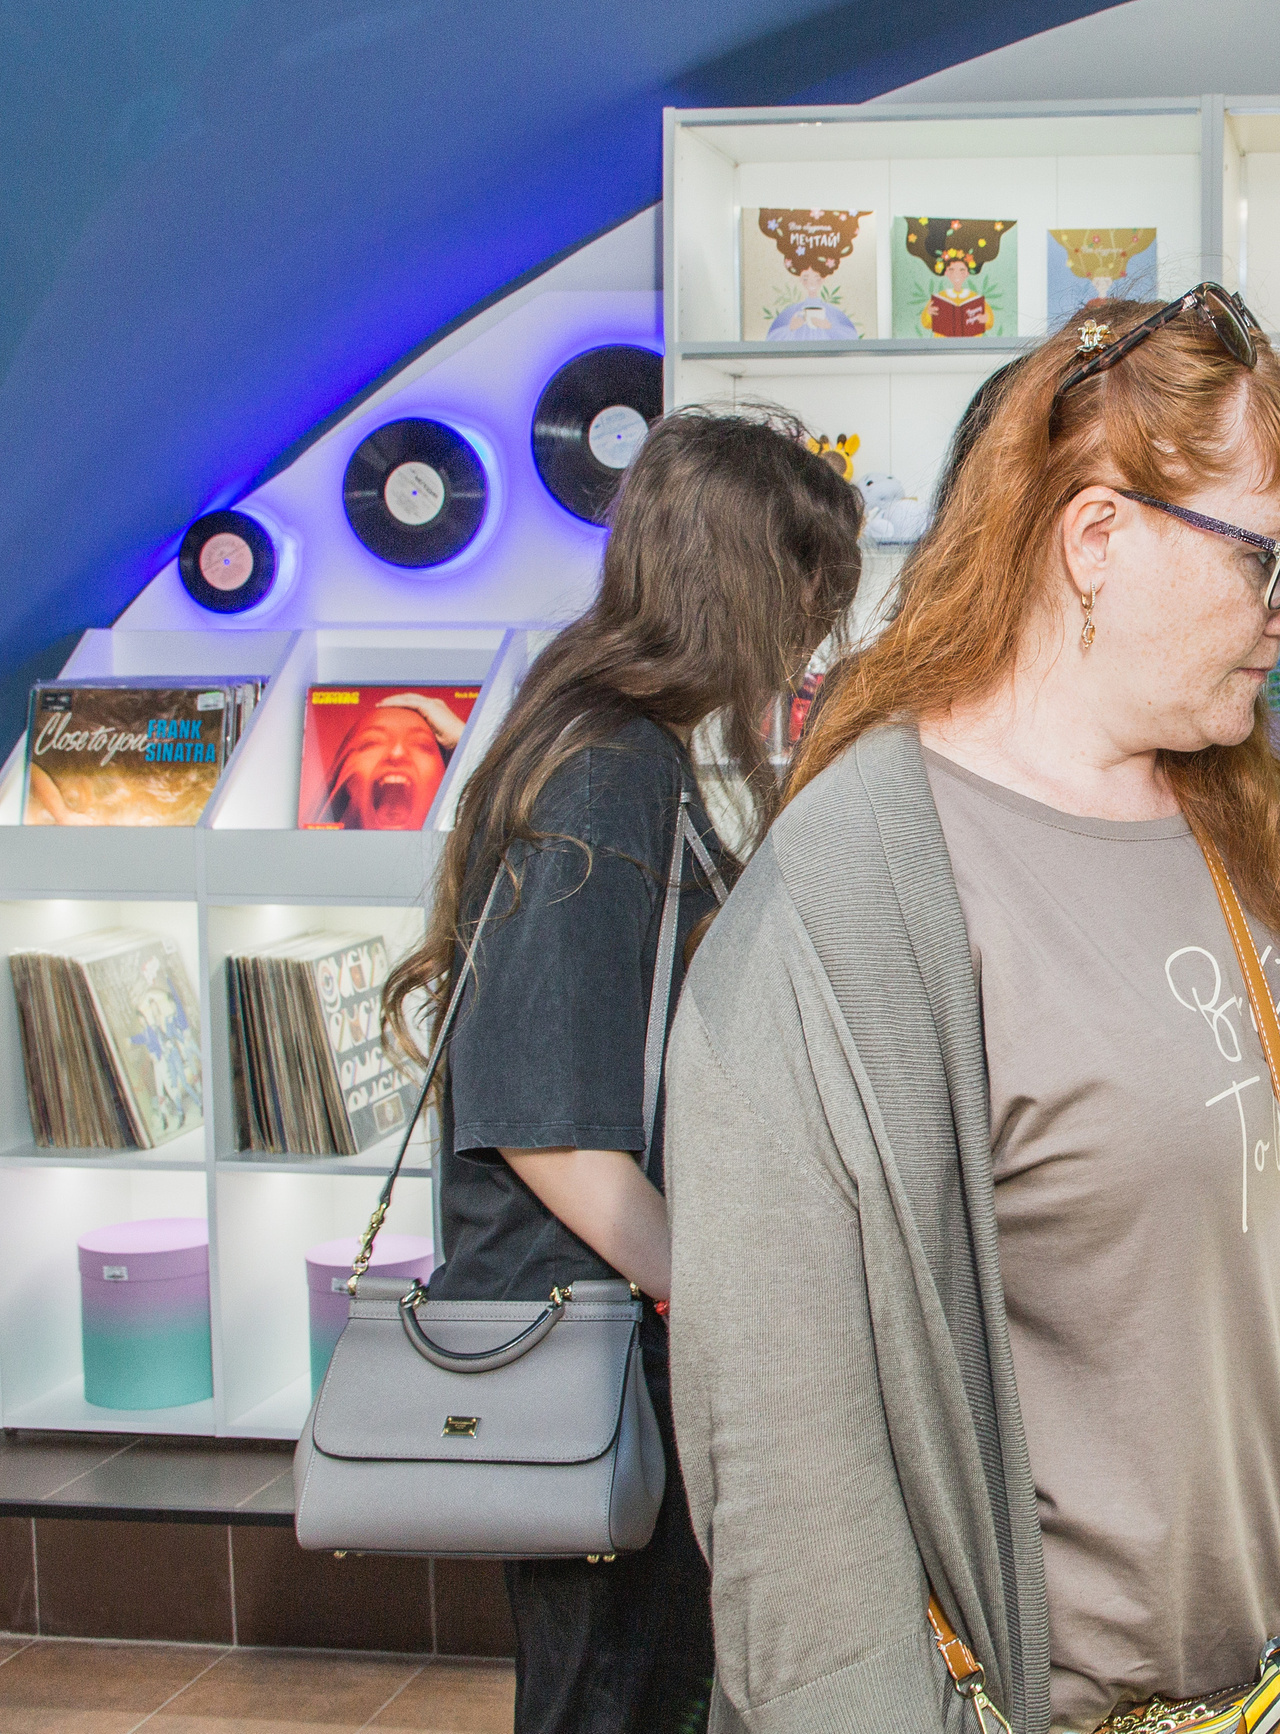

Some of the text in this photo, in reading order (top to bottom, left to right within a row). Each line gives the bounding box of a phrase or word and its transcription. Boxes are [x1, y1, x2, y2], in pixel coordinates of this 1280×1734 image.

[790, 232, 841, 249] МЕЧТАЙ!
[147, 719, 203, 739] FRANK
[34, 712, 150, 767] Close to you
[145, 743, 216, 763] SINATRA
